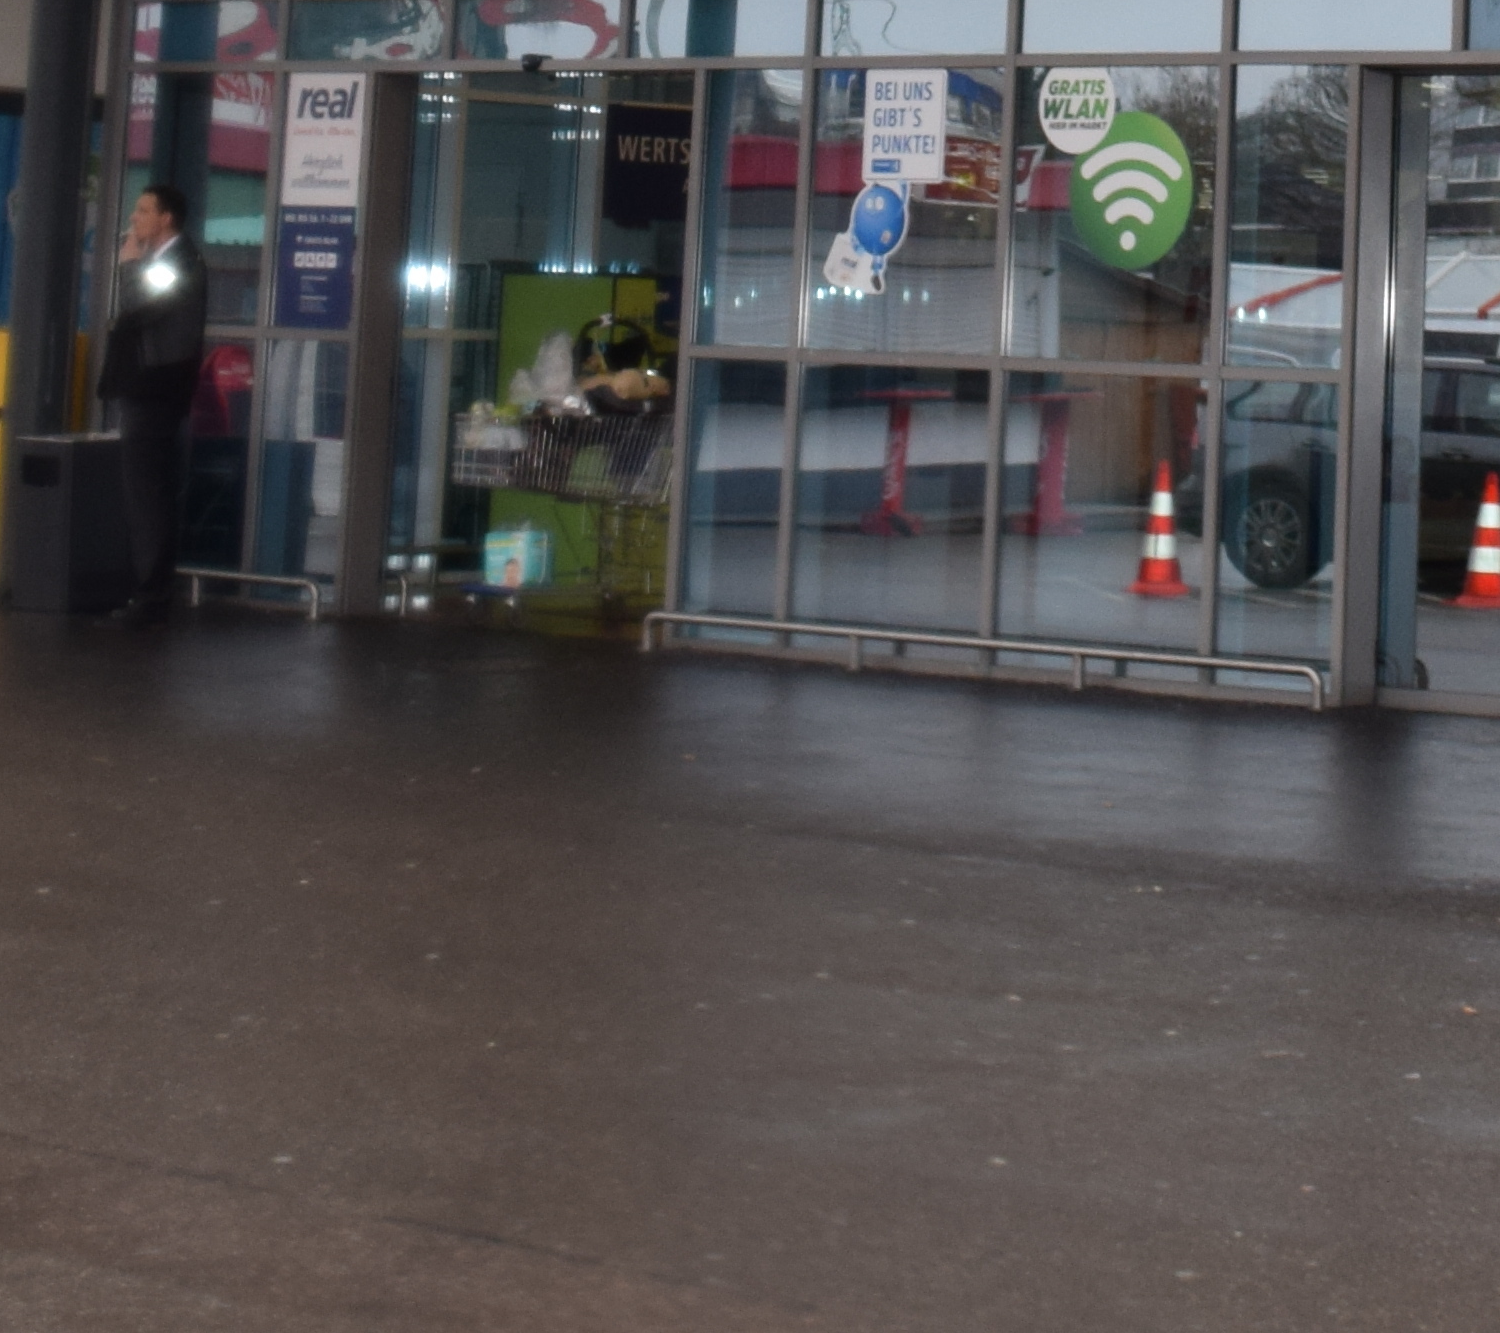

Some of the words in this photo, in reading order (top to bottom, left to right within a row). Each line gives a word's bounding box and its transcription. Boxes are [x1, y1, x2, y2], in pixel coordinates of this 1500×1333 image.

[874, 81, 898, 101] BEI
[903, 81, 933, 101] UNS
[1049, 79, 1106, 95] GRATIS
[297, 81, 359, 120] real
[1044, 98, 1109, 120] WLAN
[872, 134, 936, 155] PUNKTE!
